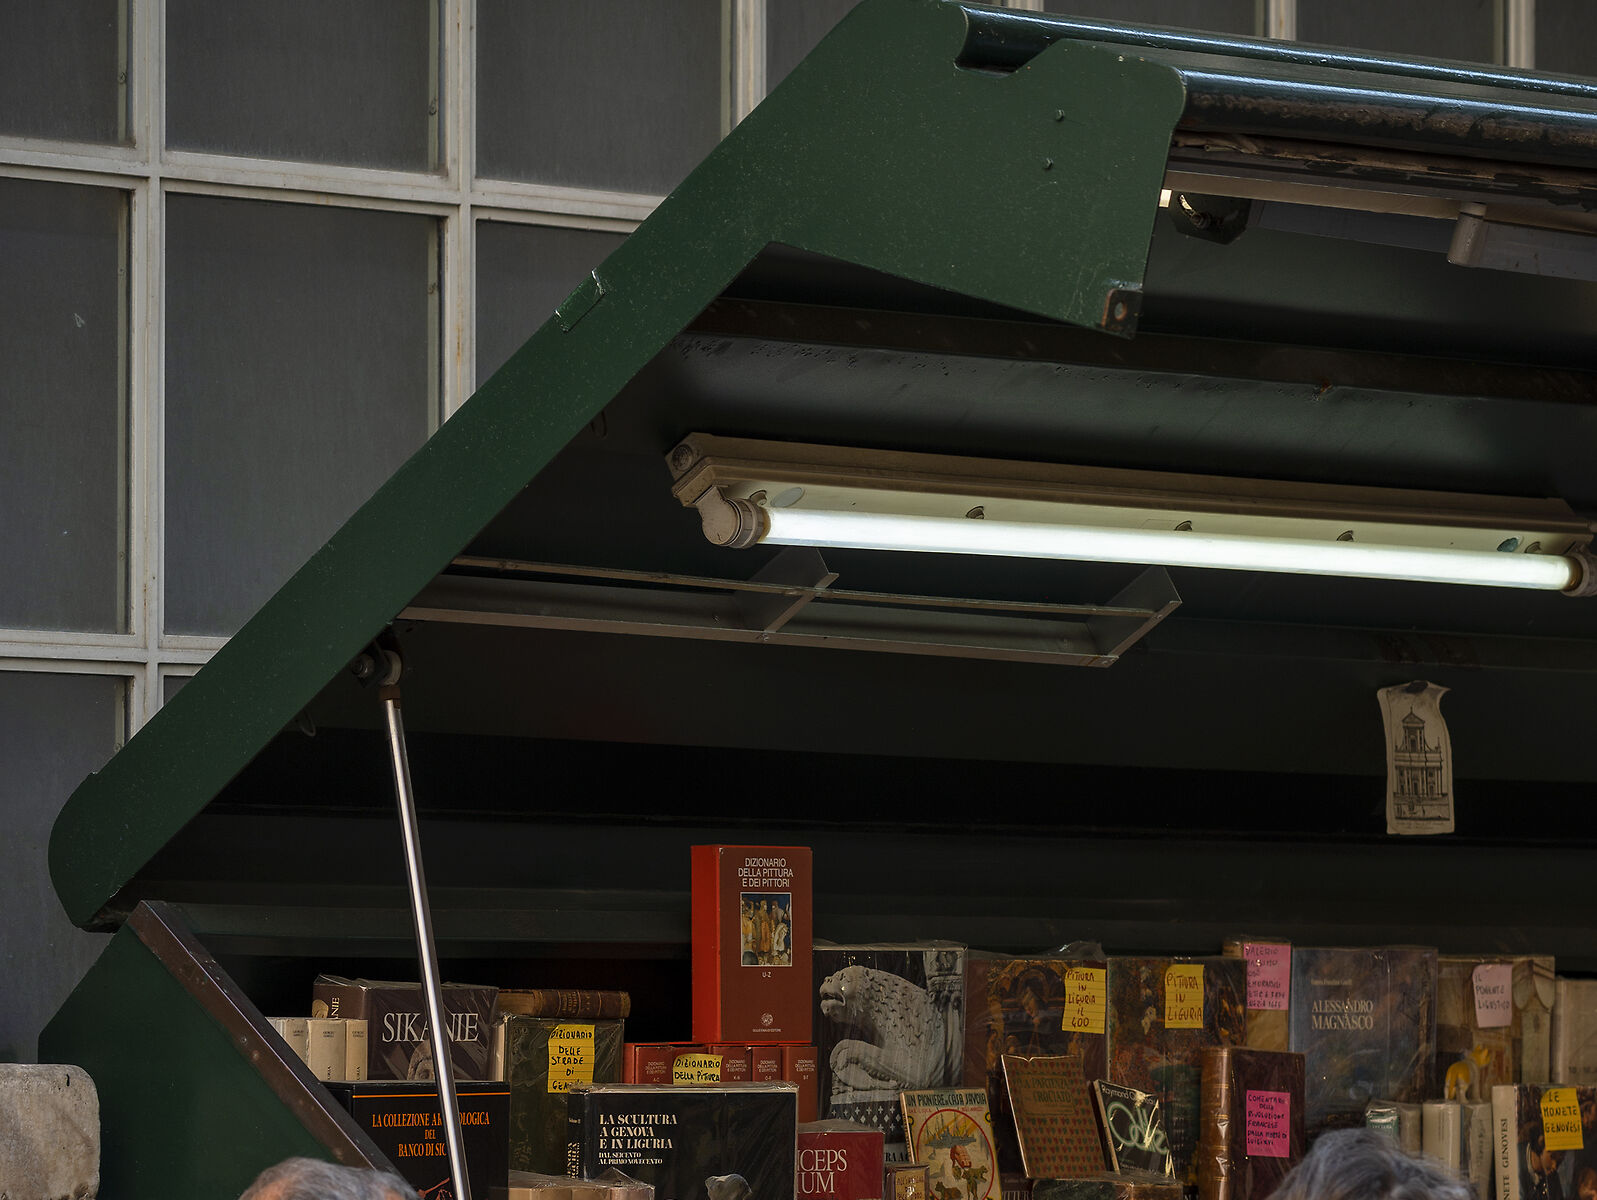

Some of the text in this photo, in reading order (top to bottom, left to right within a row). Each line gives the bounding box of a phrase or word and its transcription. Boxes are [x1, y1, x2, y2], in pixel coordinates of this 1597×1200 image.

[745, 858, 786, 867] DIZIONARIO
[738, 868, 793, 877] DELLA PITTURA
[742, 879, 790, 887] E DEI PITTORI
[1312, 1000, 1373, 1012] ALESSANDRO
[1168, 1005, 1203, 1021] LIGURIA
[1312, 1015, 1373, 1030] MAGNASCO
[559, 1046, 581, 1056] DELLE
[552, 1057, 584, 1065] STRADE
[675, 1059, 720, 1069] DIZIONARIO
[1549, 1091, 1560, 1102] LE
[1544, 1106, 1577, 1116] MONETE
[372, 1114, 381, 1127] LA
[383, 1113, 430, 1127] COLLEZIONE
[600, 1114, 677, 1124] LA SCULTURA
[1545, 1120, 1580, 1133] GENOVESI
[424, 1129, 436, 1139] DEL
[600, 1127, 654, 1137] A GENOVA
[600, 1138, 673, 1149] E IN LIGURIA
[1501, 1118, 1509, 1168] GENOVESI
[398, 1143, 423, 1157] BANCO
[425, 1143, 433, 1156] DI
